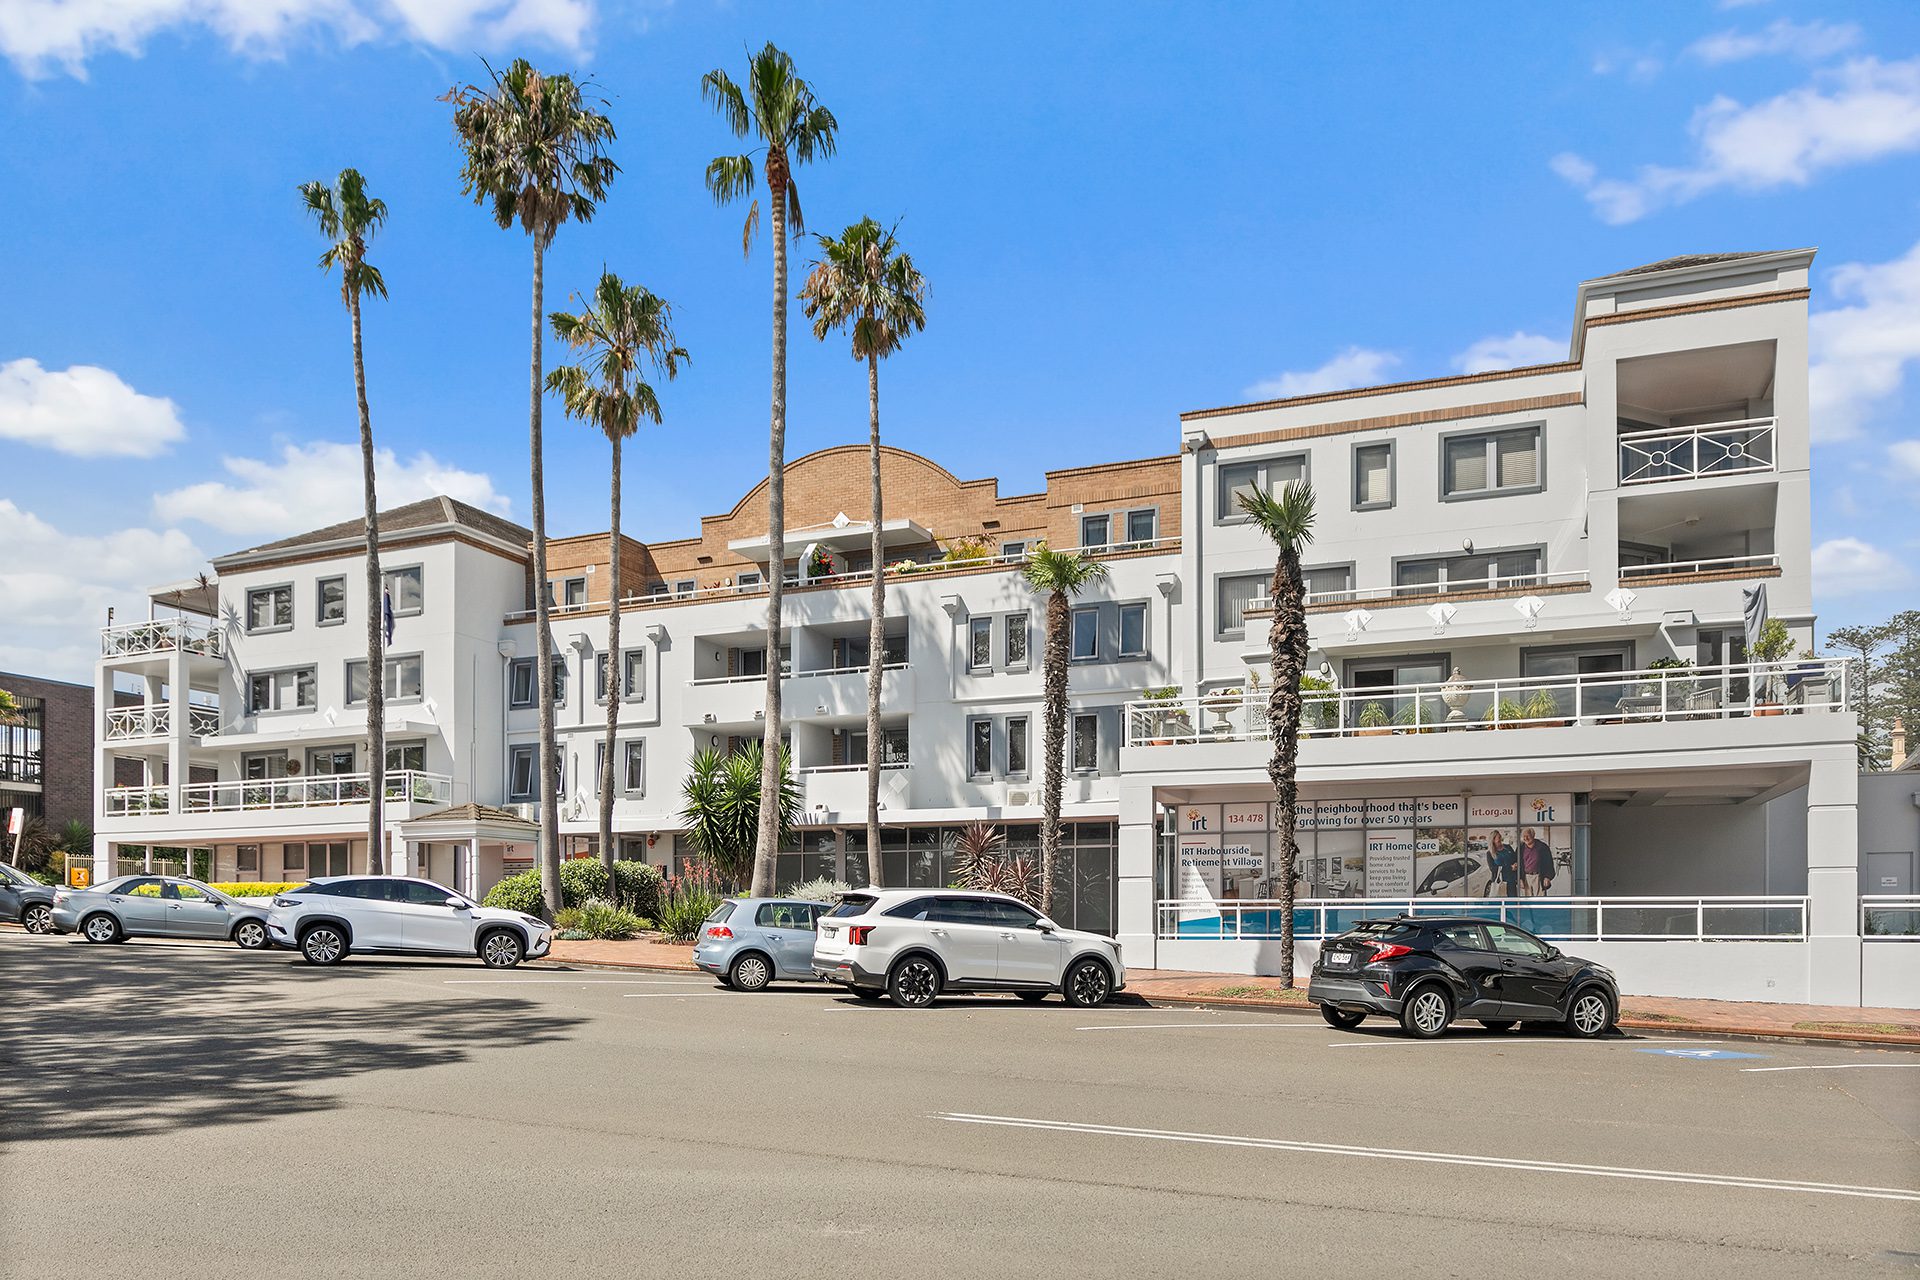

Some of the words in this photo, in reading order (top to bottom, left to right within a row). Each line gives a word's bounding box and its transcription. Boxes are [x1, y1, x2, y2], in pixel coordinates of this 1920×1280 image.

[1297, 805, 1313, 814] the
[1317, 803, 1397, 815] neighbourhood
[1398, 802, 1429, 812] that's
[1432, 801, 1458, 811] been
[1472, 807, 1513, 818] irt.org.au
[1228, 814, 1244, 823] 134
[1247, 814, 1264, 823] 478
[1537, 806, 1555, 822] irt
[1192, 816, 1207, 830] irt
[1300, 816, 1341, 828] growing
[1343, 815, 1357, 824] for
[1361, 816, 1385, 824] over
[1388, 815, 1400, 824] 50
[1403, 815, 1432, 825] years
[1181, 848, 1195, 856] IRT
[1196, 846, 1250, 856] Harbourside
[1369, 843, 1383, 851] IRT
[1385, 842, 1413, 851] Home
[1416, 841, 1436, 850] Care
[1181, 858, 1231, 867] Retirement
[1233, 857, 1262, 868] Village
